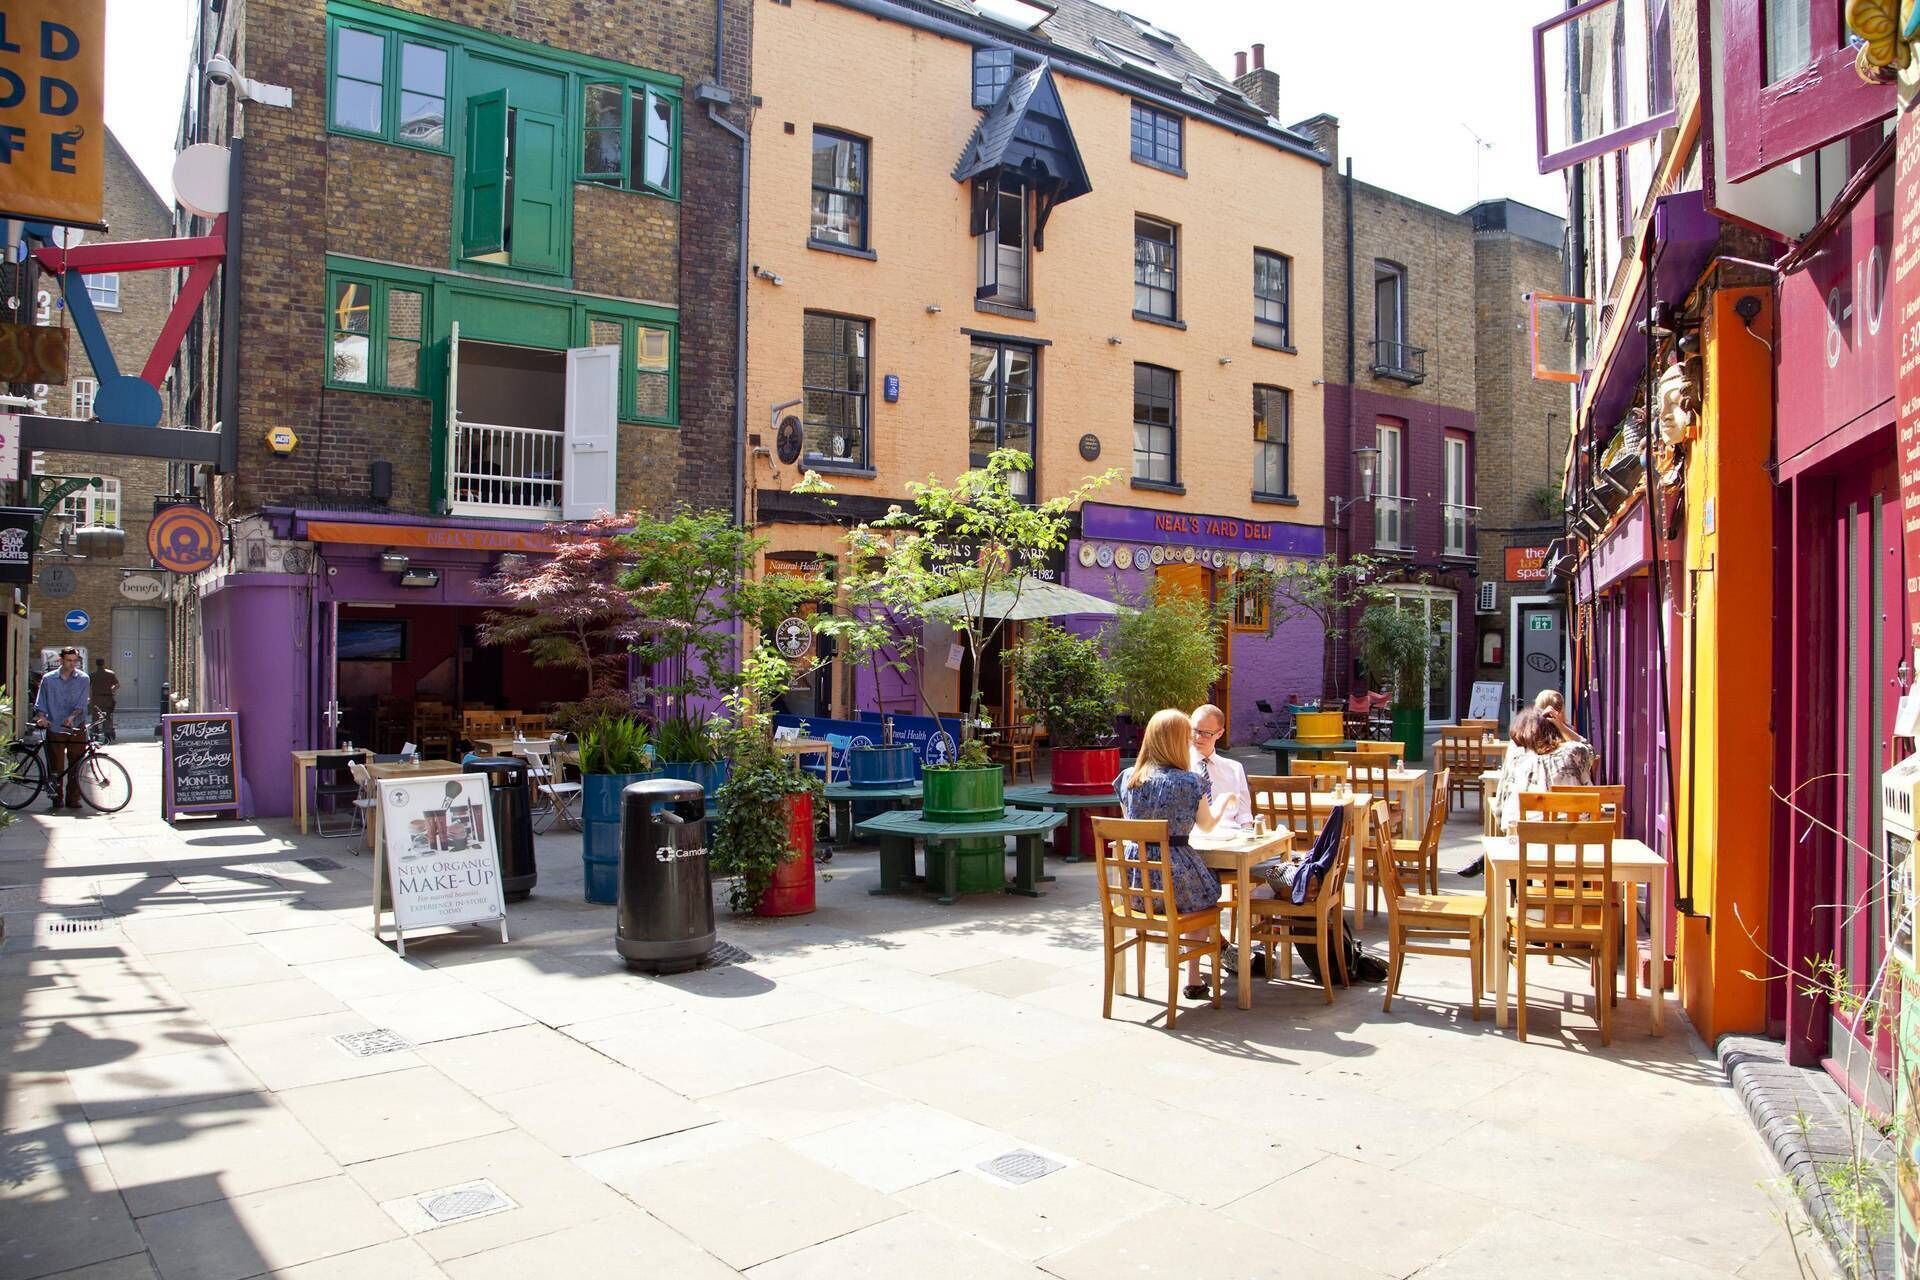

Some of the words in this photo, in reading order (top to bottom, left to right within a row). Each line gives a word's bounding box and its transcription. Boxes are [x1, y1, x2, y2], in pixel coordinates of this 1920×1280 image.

[1826, 245, 1884, 369] 8-10
[1154, 514, 1200, 535] NEAL'S
[1205, 520, 1239, 537] YARD
[1244, 522, 1273, 541] DELI
[1, 536, 24, 544] SLAM
[2, 544, 23, 552] CITY
[1525, 548, 1545, 559] the
[769, 561, 798, 571] Natural
[122, 581, 159, 595] benefit
[908, 729, 927, 741] Health
[398, 864, 429, 877] NEW
[432, 857, 491, 873] ORGANIC
[399, 869, 494, 895] MAKE-UP
